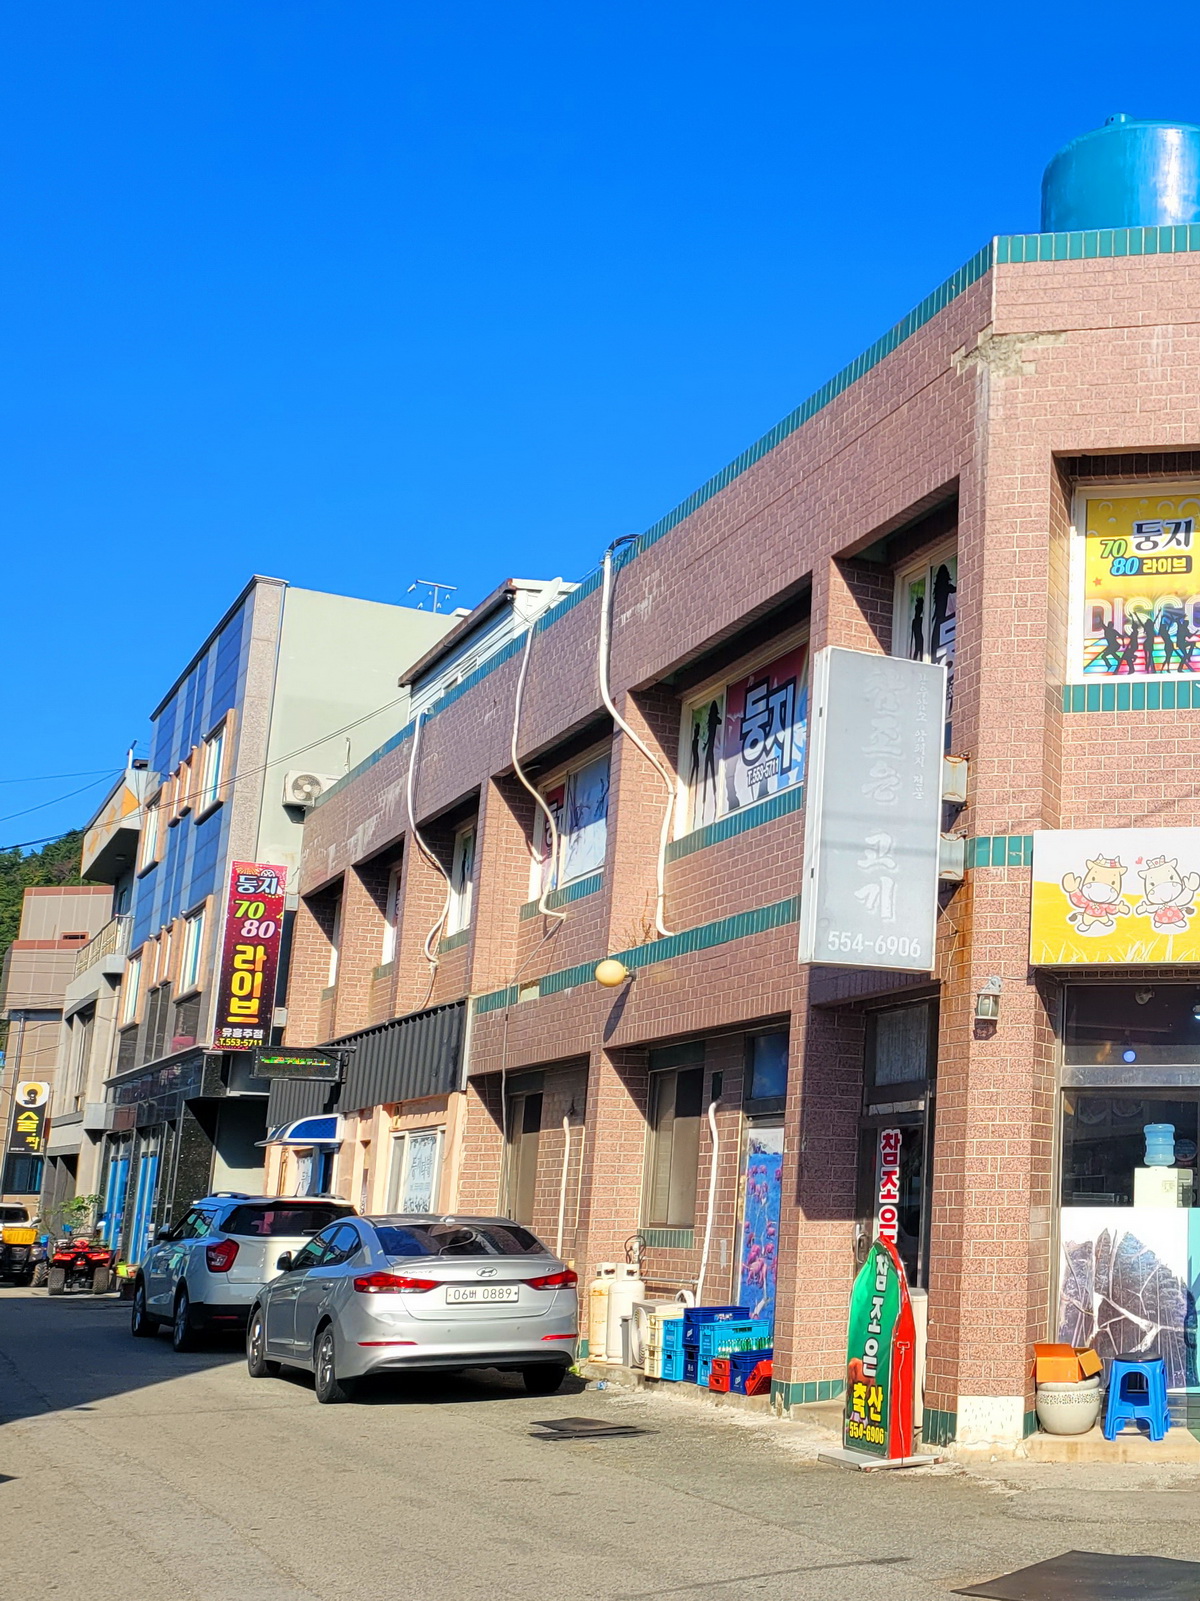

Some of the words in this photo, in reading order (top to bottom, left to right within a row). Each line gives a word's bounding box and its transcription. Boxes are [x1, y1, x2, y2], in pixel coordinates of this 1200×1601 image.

[1100, 538, 1128, 559] 70
[1133, 519, 1194, 552] 둥지
[1110, 556, 1140, 577] 80
[1142, 557, 1187, 574] 라이브
[740, 676, 797, 775] 둥지
[747, 758, 780, 788] T.553-5711
[236, 873, 279, 895] 둥지
[853, 831, 898, 922] 고기
[234, 900, 266, 920] 70
[240, 920, 276, 939] 80
[827, 930, 922, 958] 554-6906
[227, 944, 267, 1023] 라이브
[219, 1037, 263, 1047] T.553-5711
[222, 1027, 264, 1039] 유흥주점
[879, 1129, 902, 1244] 참조은
[453, 1289, 477, 1301] 06버
[482, 1288, 512, 1300] 0889
[862, 1253, 889, 1378] 참조은
[852, 1382, 883, 1422] 축산
[849, 1421, 885, 1446] 554-6906
